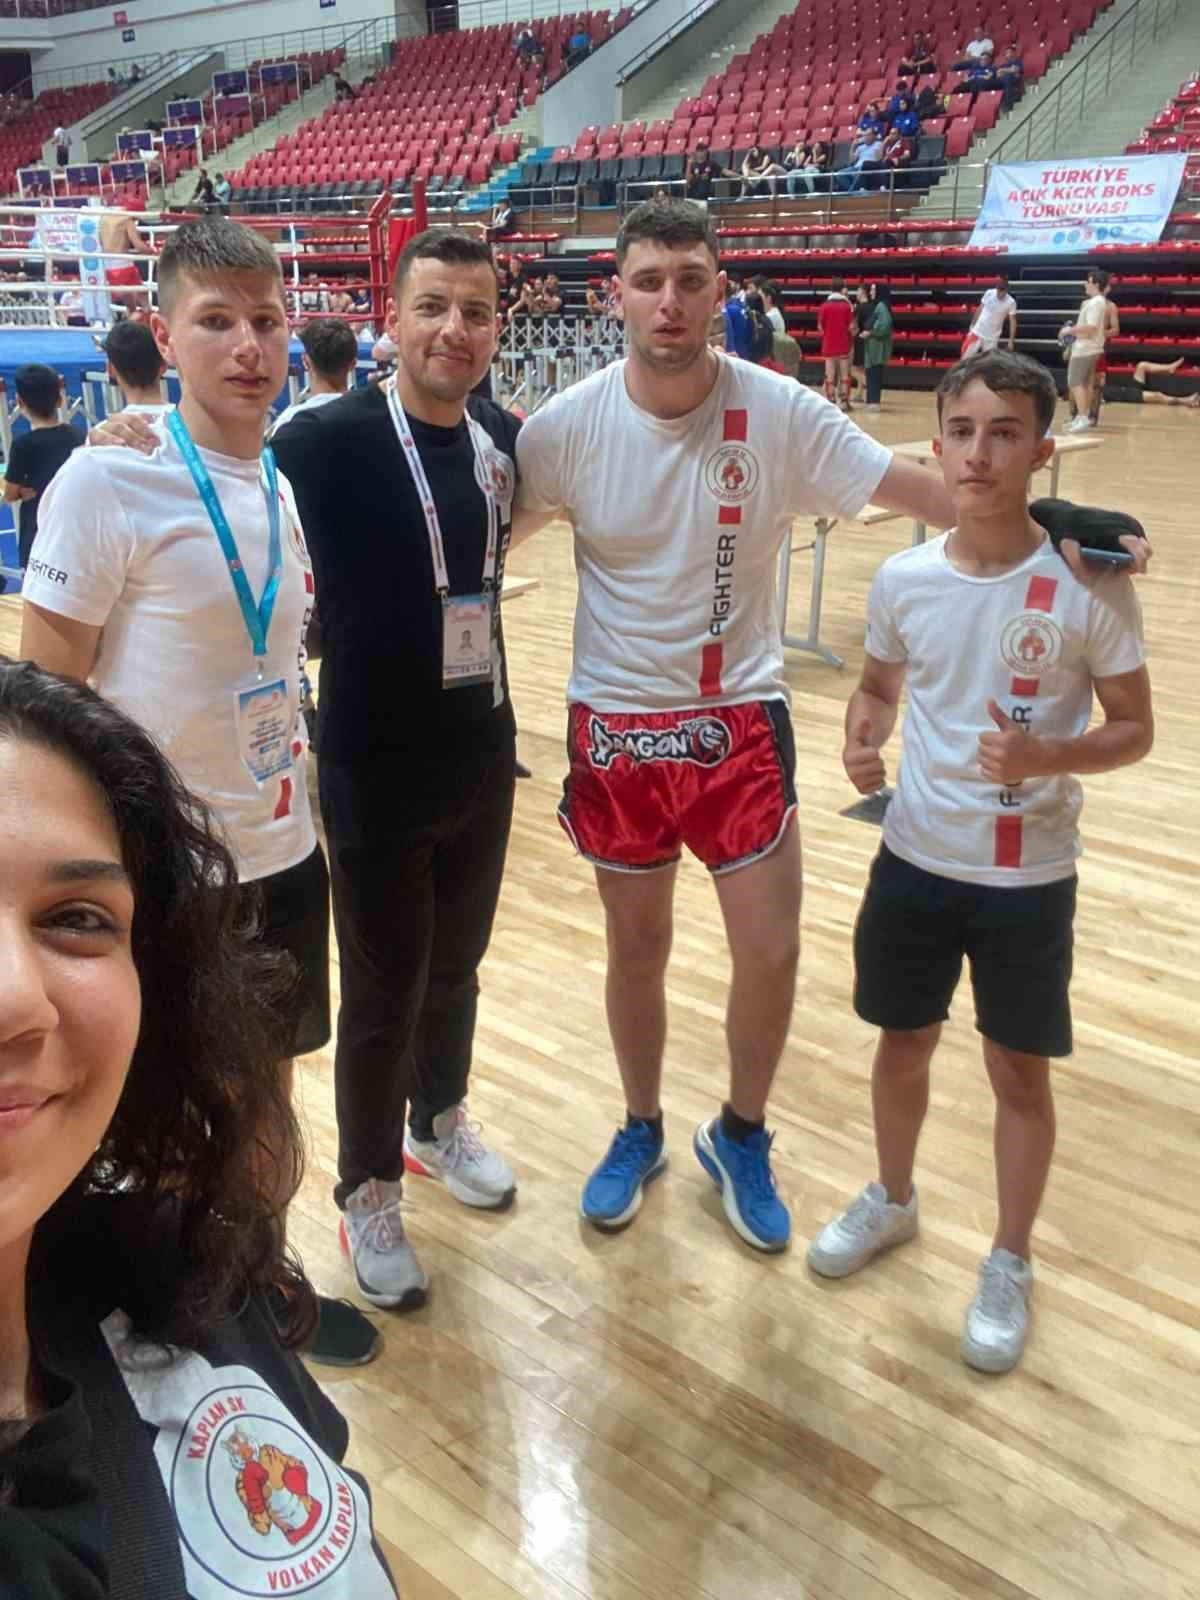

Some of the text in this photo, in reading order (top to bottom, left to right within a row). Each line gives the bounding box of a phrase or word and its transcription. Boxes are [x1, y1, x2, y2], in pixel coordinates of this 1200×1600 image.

[1041, 164, 1129, 184] TÜRKİYE
[1101, 183, 1155, 198] BOKS
[710, 534, 736, 636] FIGHTER
[187, 1396, 247, 1460] KAPLAN SK
[267, 1482, 353, 1590] VOLKAN KAPLAN
